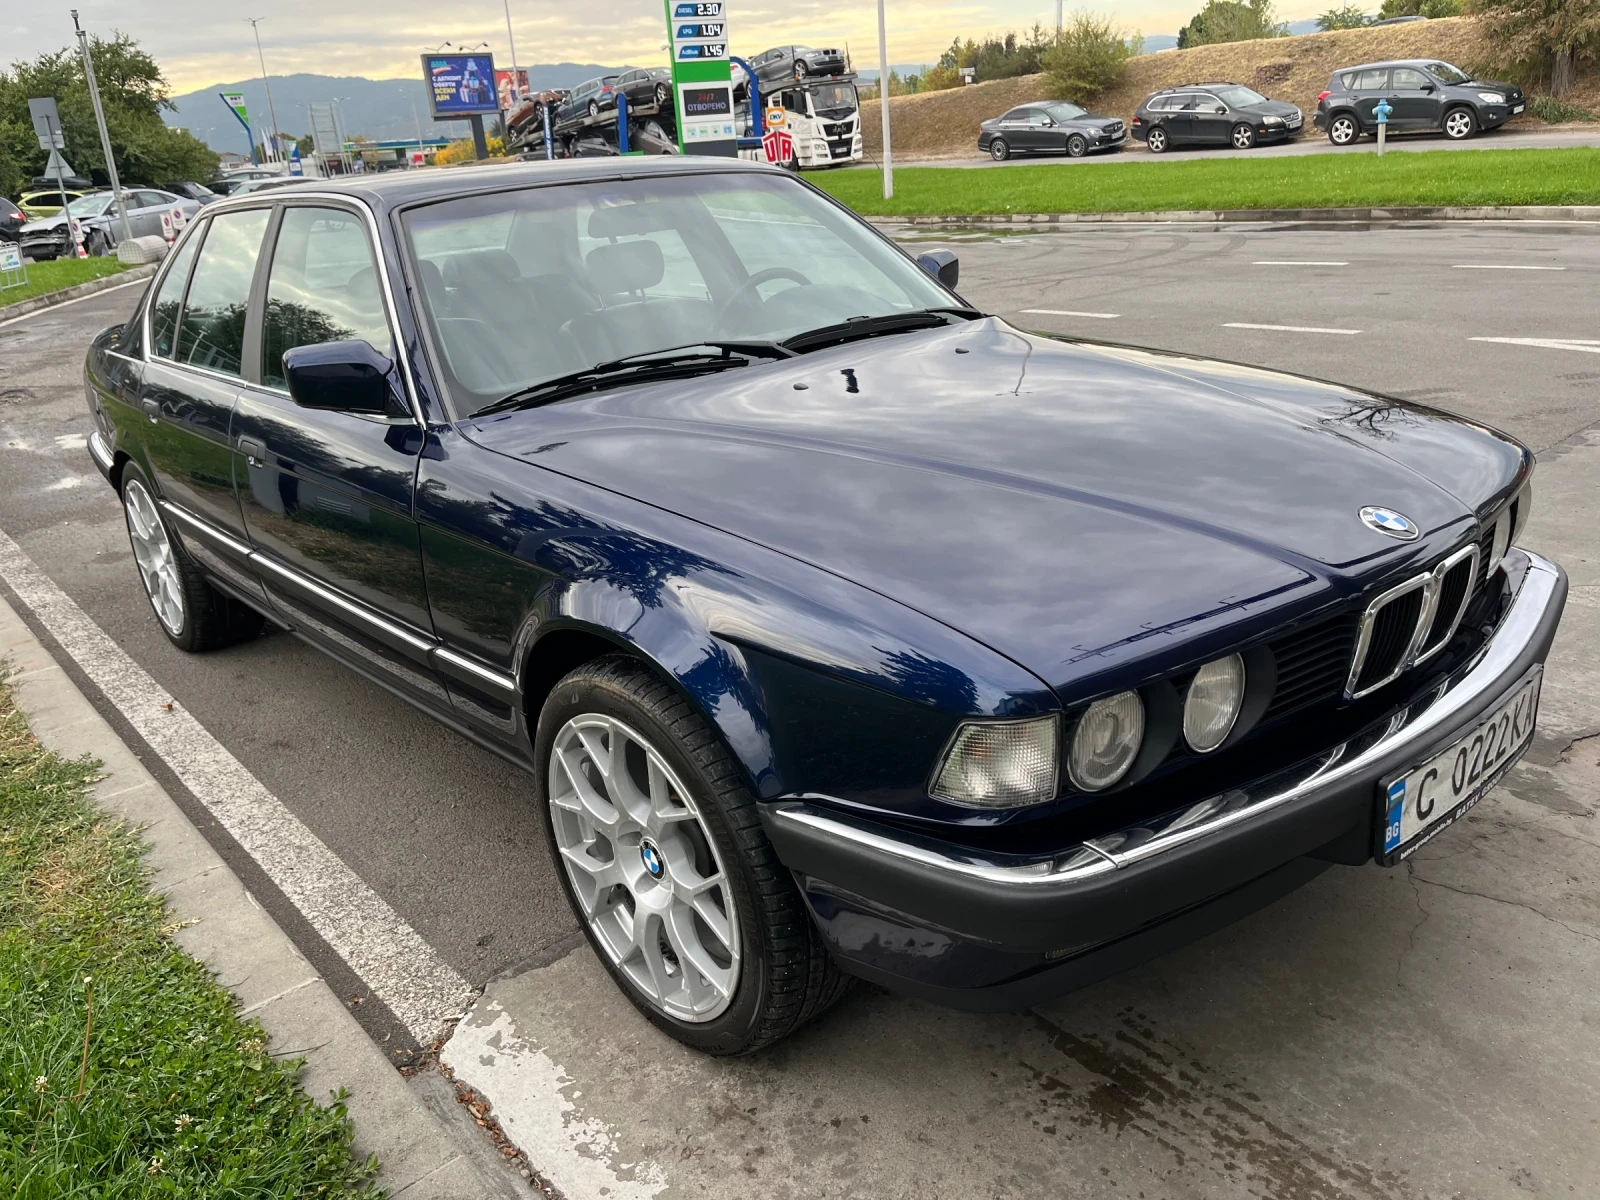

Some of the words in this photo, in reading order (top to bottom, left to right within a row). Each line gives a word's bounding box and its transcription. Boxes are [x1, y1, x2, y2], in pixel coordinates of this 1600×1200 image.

[697, 3, 719, 15] 2.30
[701, 24, 721, 36] 1.04
[703, 45, 723, 56] 1.45
[697, 93, 715, 102] 24/7
[687, 102, 726, 111] ОТВОРЕНО
[1416, 767, 1438, 821] C
[1455, 795, 1481, 819] BATEV
[1385, 822, 1399, 842] BG
